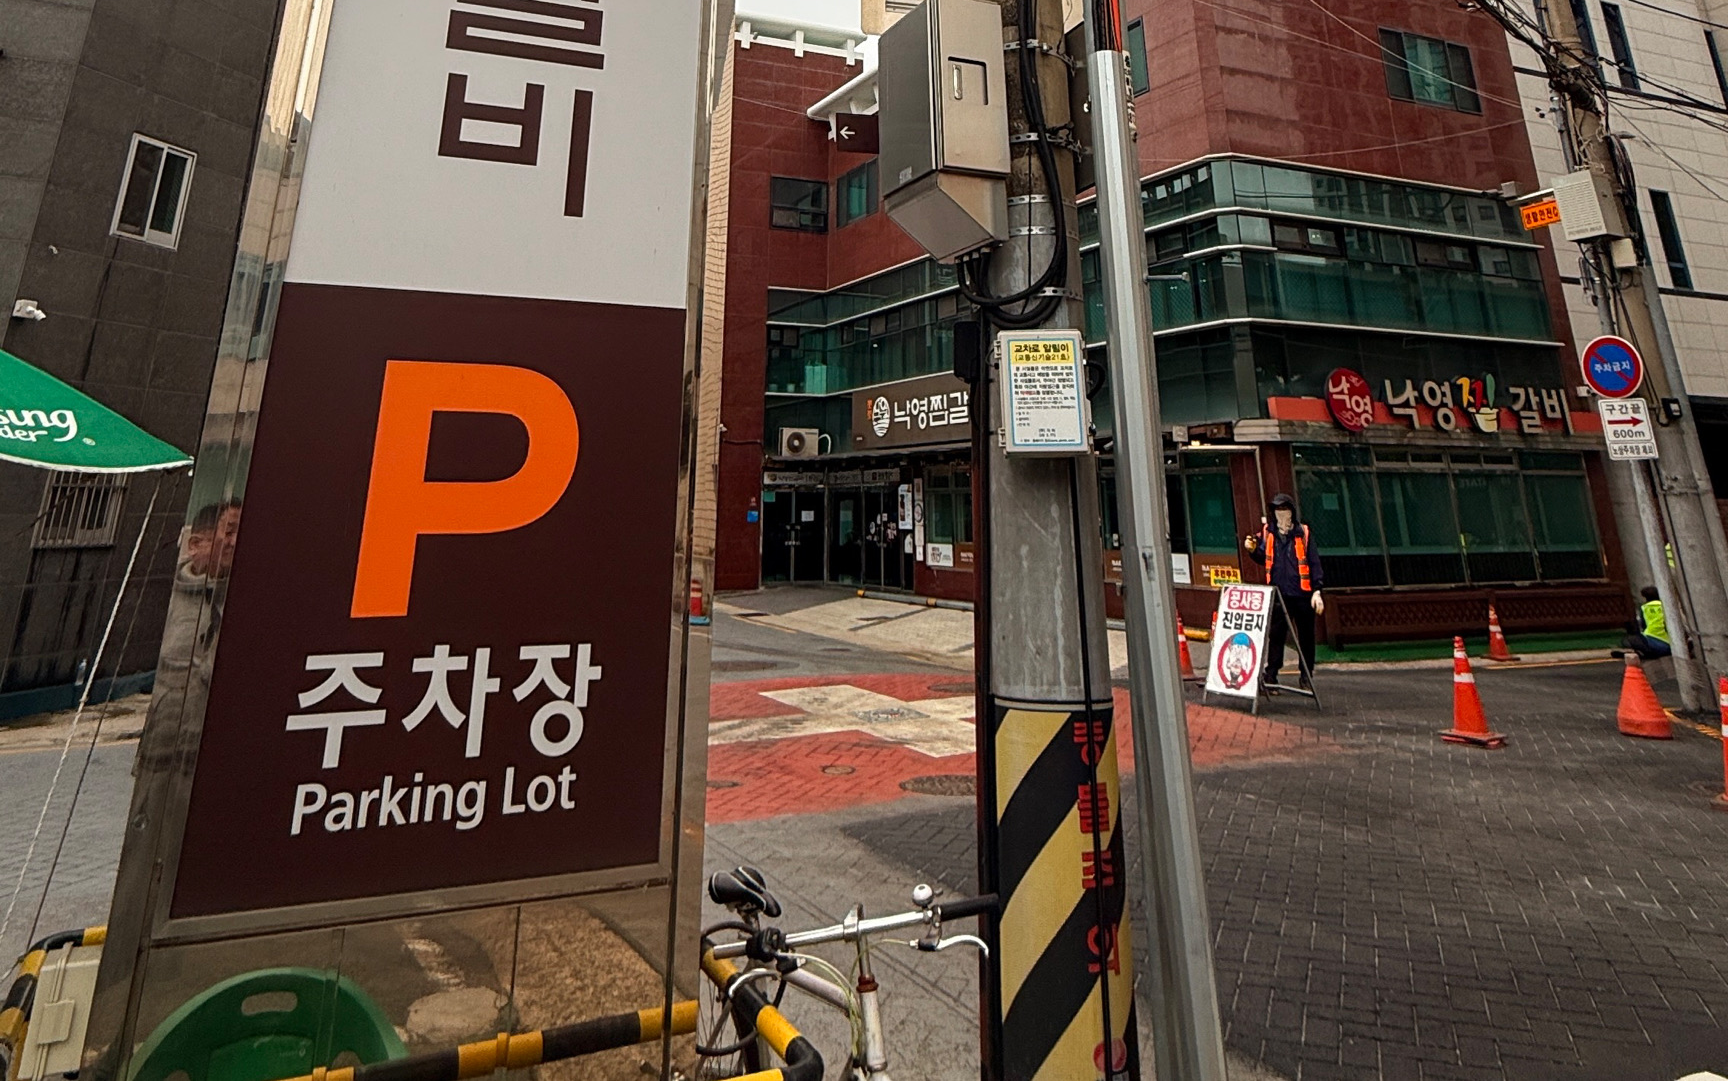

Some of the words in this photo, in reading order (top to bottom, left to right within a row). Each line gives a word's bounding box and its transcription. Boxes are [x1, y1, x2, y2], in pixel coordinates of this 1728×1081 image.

[1014, 344, 1040, 353] 교차로
[1594, 360, 1631, 373] 주차금지
[1605, 403, 1642, 415] 구간끝
[1613, 428, 1646, 439] 600m
[350, 359, 580, 619] P
[1229, 591, 1264, 610] 공사중
[1222, 611, 1265, 632] 진입금지
[285, 643, 601, 770] 주차장
[290, 772, 489, 835] Parking
[502, 765, 578, 816] Lot
